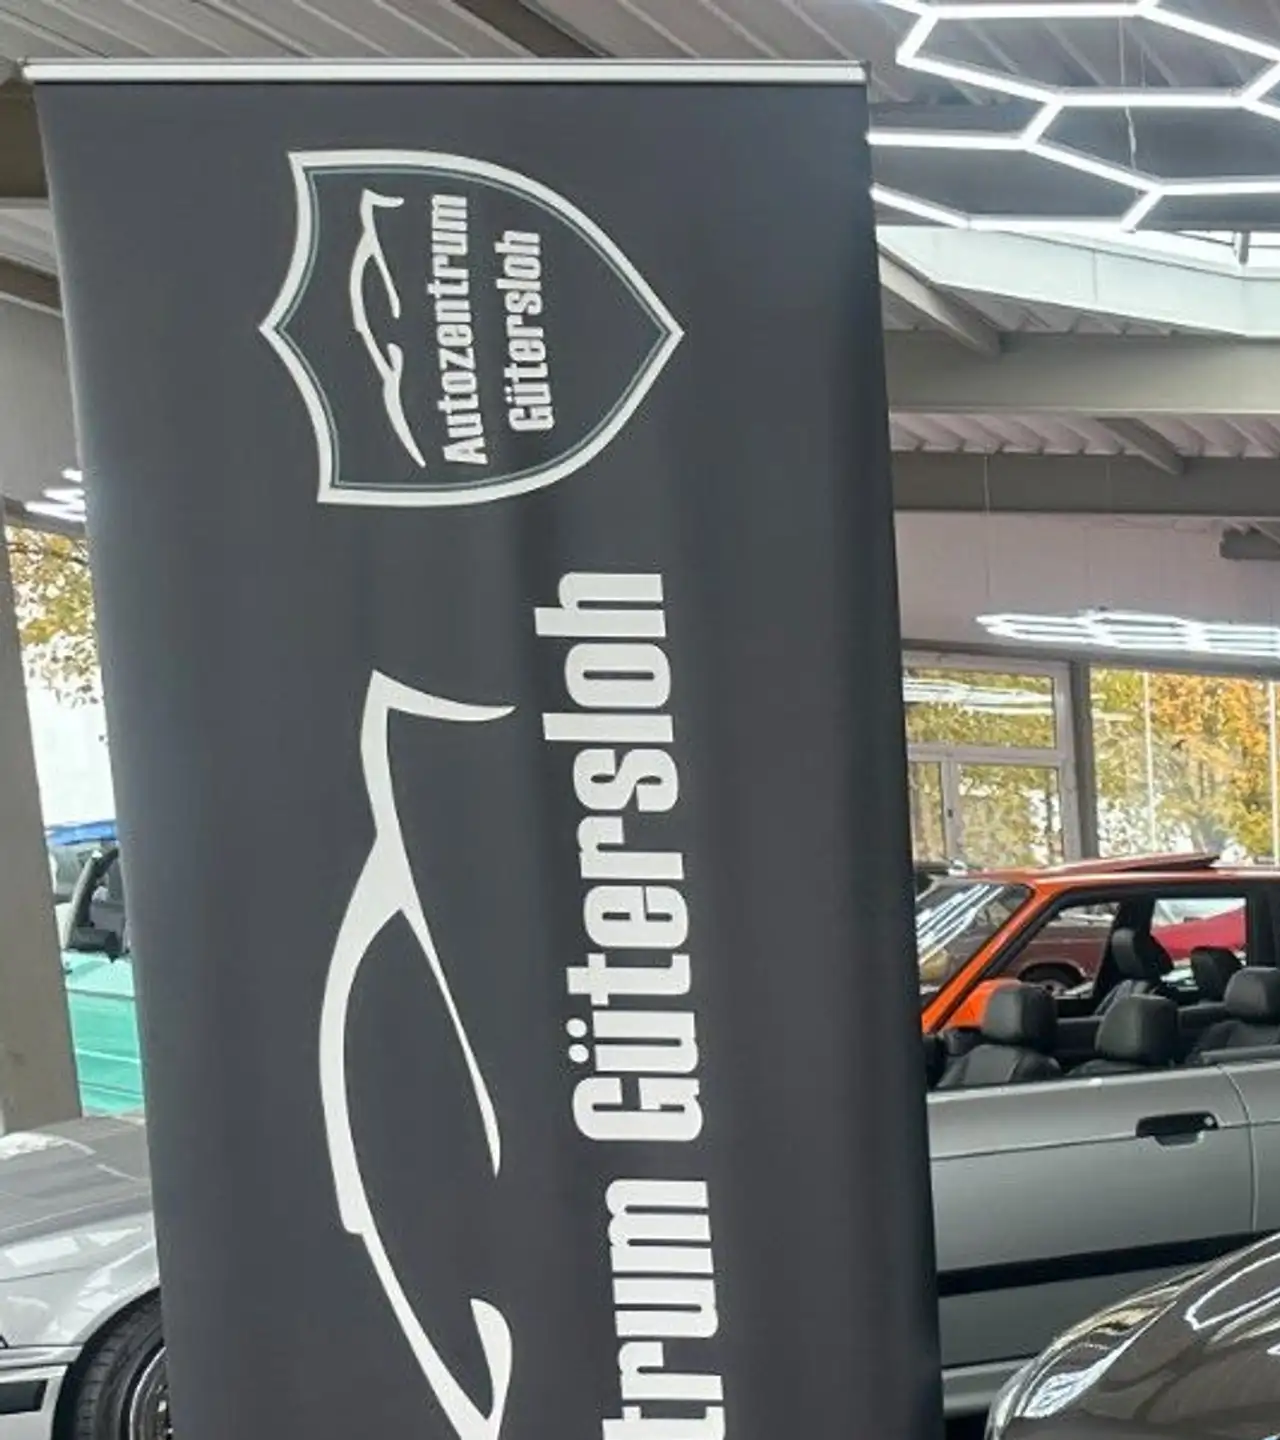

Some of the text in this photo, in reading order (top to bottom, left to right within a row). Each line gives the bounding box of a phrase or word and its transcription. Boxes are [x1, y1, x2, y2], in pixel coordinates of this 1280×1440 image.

[429, 194, 488, 465] Autozentrum
[495, 229, 555, 432] Gütersloh
[534, 571, 703, 1142] Gütersloh
